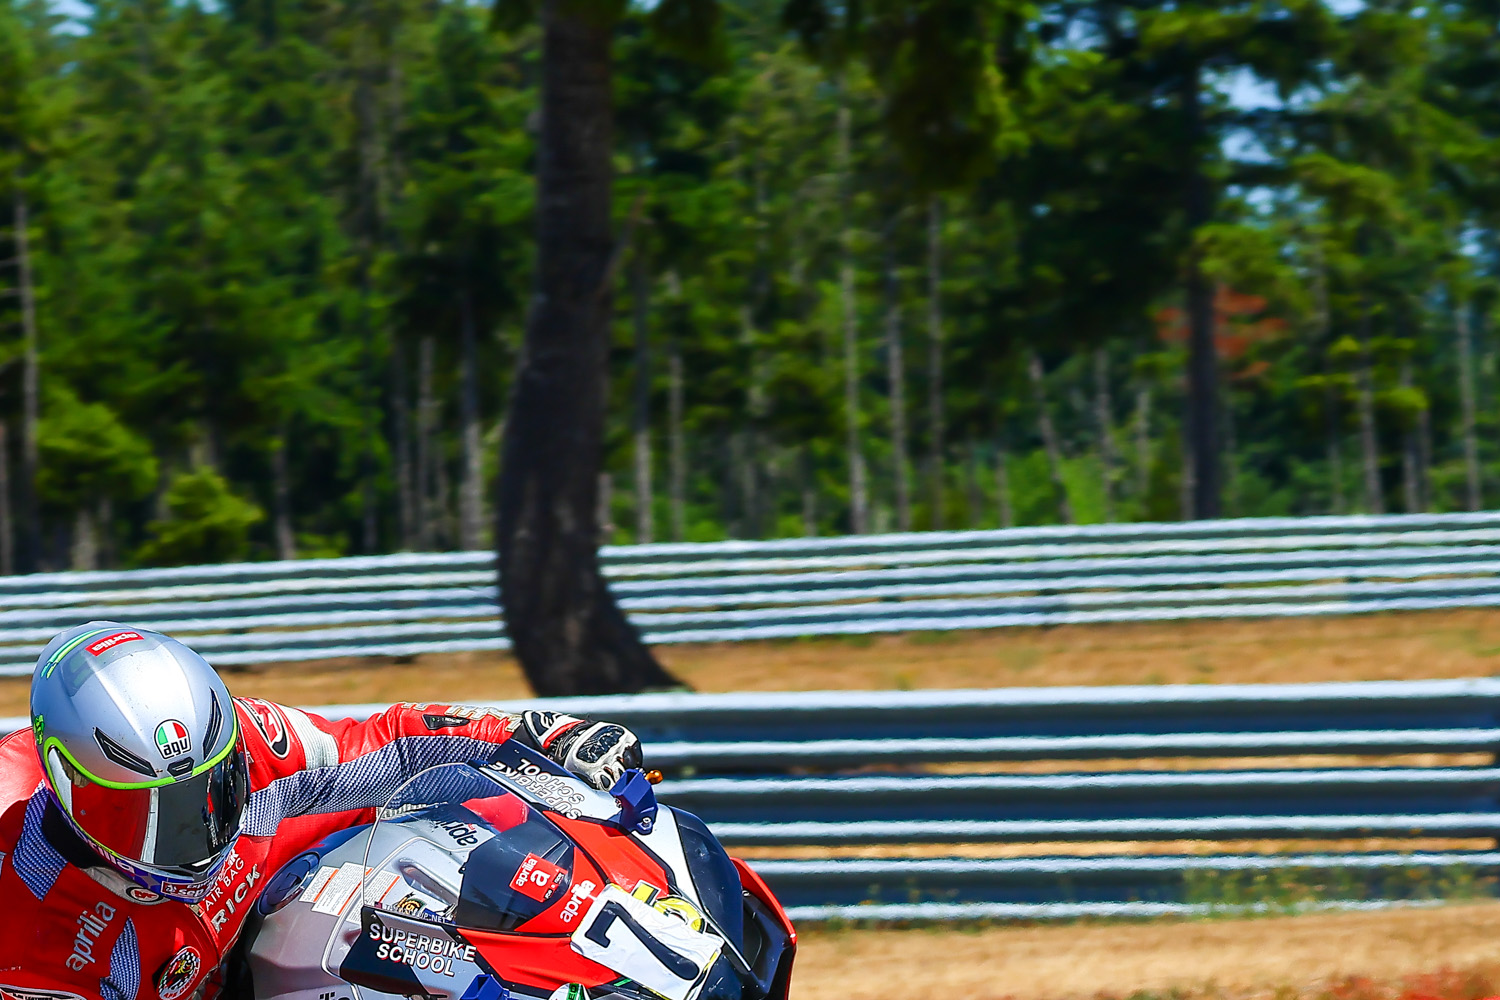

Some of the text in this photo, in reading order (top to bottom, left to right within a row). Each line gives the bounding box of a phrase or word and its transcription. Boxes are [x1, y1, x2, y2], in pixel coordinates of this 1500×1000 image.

[92, 633, 139, 652] aprilia
[163, 739, 189, 757] agv
[488, 761, 582, 820] SUPERBIKE
[517, 758, 585, 804] SCHOOL
[205, 887, 223, 911] AIR
[223, 858, 244, 887] BAG
[515, 858, 538, 887] aprilia
[211, 863, 262, 934] RICK
[560, 879, 597, 923] aprilia
[66, 900, 117, 971] aprilia
[369, 923, 477, 962] SUPERBIKE
[584, 899, 700, 981] 7
[376, 943, 455, 977] SCHOOL
